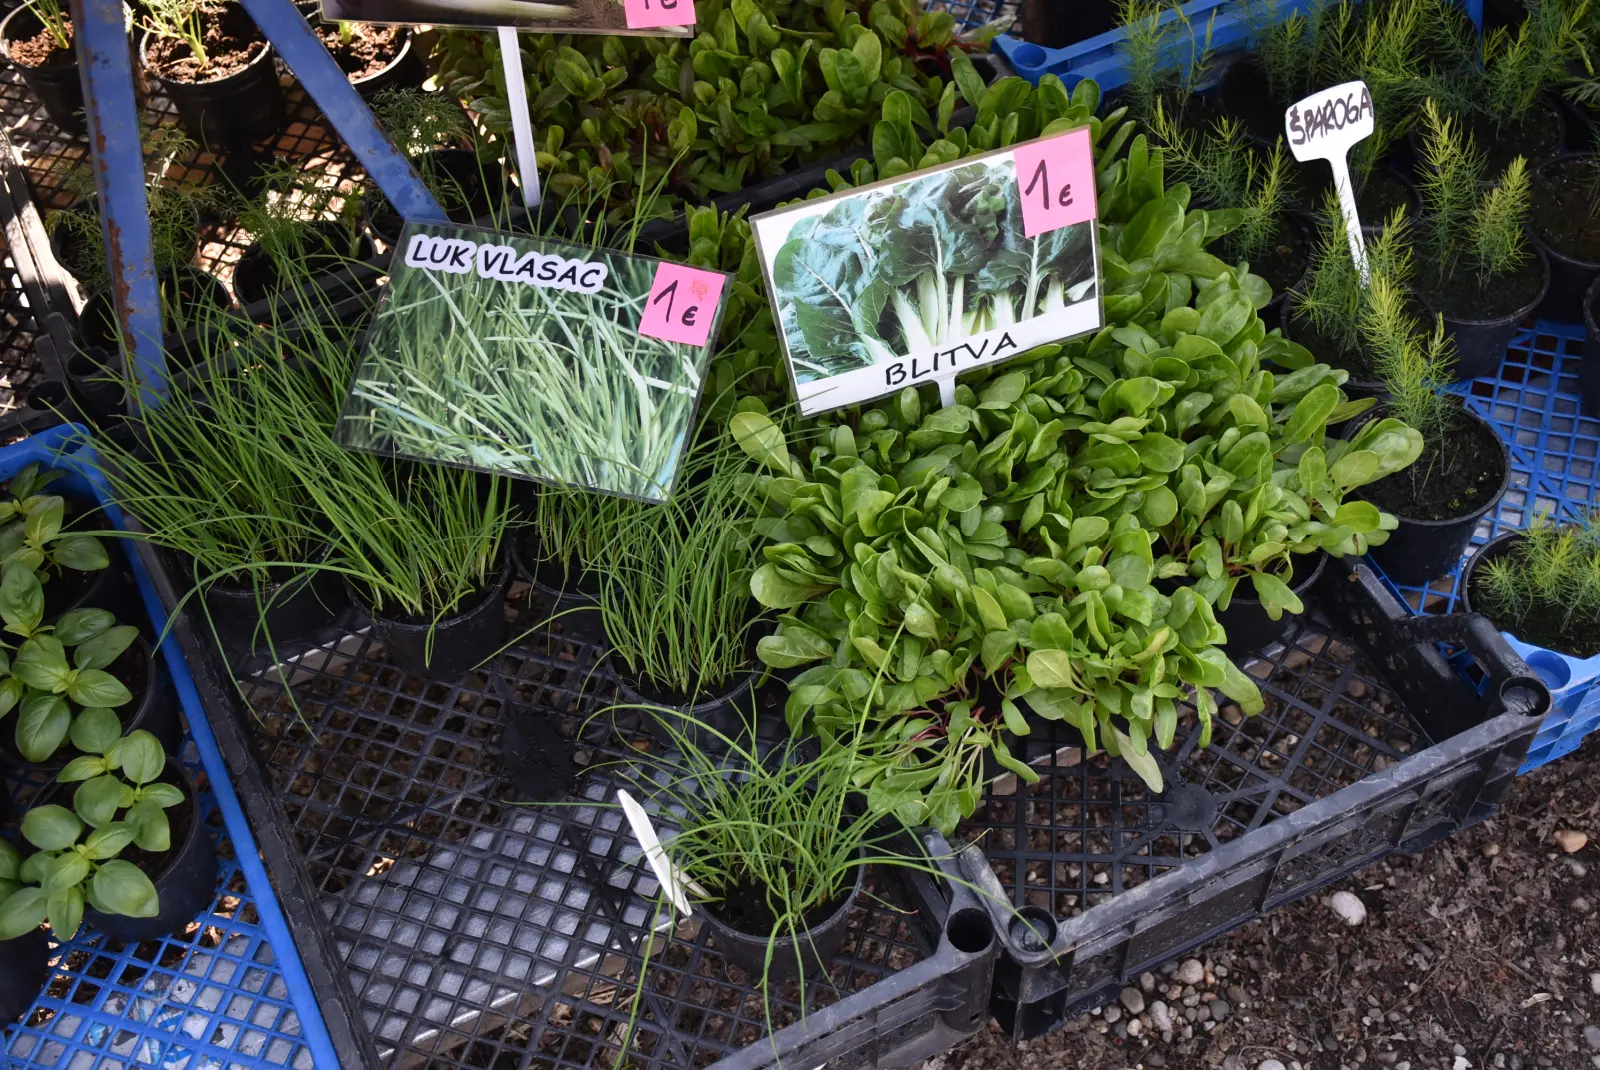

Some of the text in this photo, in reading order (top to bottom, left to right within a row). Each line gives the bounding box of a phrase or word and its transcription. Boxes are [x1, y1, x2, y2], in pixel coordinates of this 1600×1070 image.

[411, 240, 602, 289] LUK VLASAC
[885, 331, 1018, 387] BLITVA
